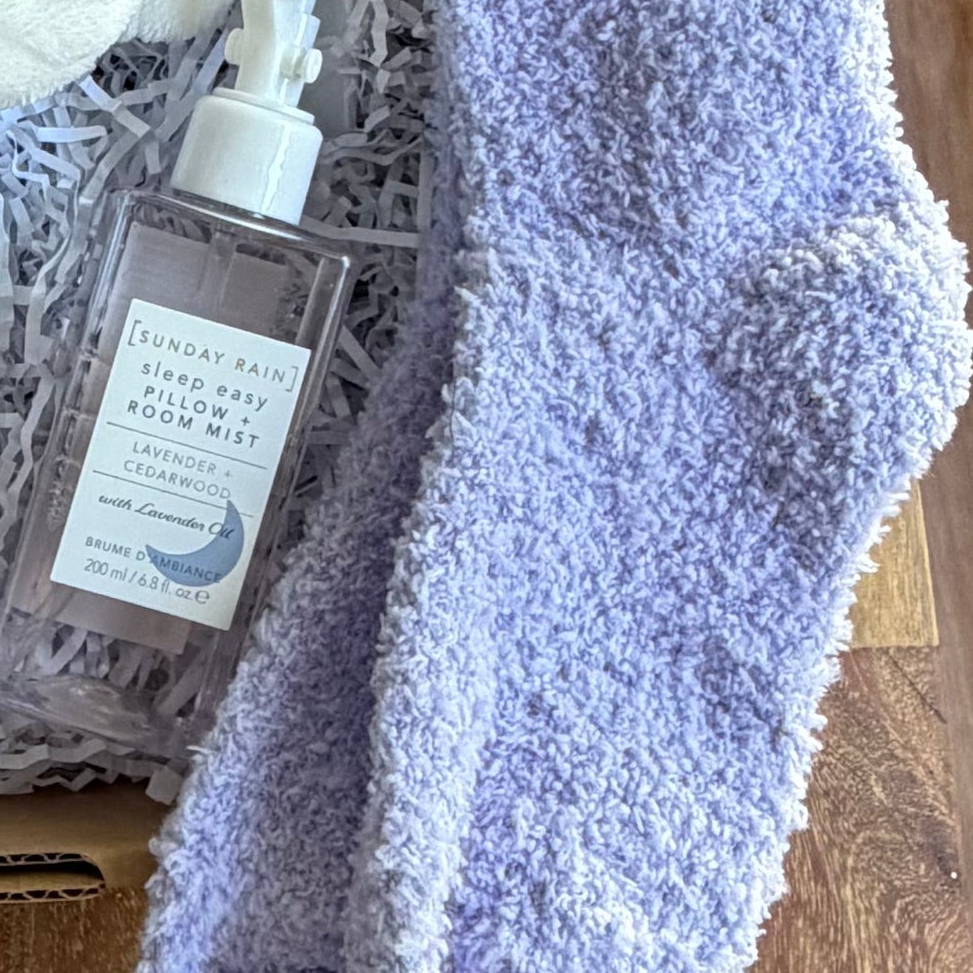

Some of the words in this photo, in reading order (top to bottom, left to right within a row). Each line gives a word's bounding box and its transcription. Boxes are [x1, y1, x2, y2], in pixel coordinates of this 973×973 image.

[142, 361, 204, 392] sleep
[216, 385, 268, 412] easy
[144, 385, 230, 420] PILLOW
[127, 400, 193, 431] ROOM
[205, 423, 260, 448] MIST
[133, 442, 217, 476] LAVENDER
[123, 460, 231, 500] CEDARWOOD
[98, 494, 132, 510] with
[134, 503, 205, 532] Lavender
[208, 522, 236, 539] Oil
[85, 536, 131, 558] BRUME
[84, 558, 109, 576] 200
[110, 567, 127, 582] ml
